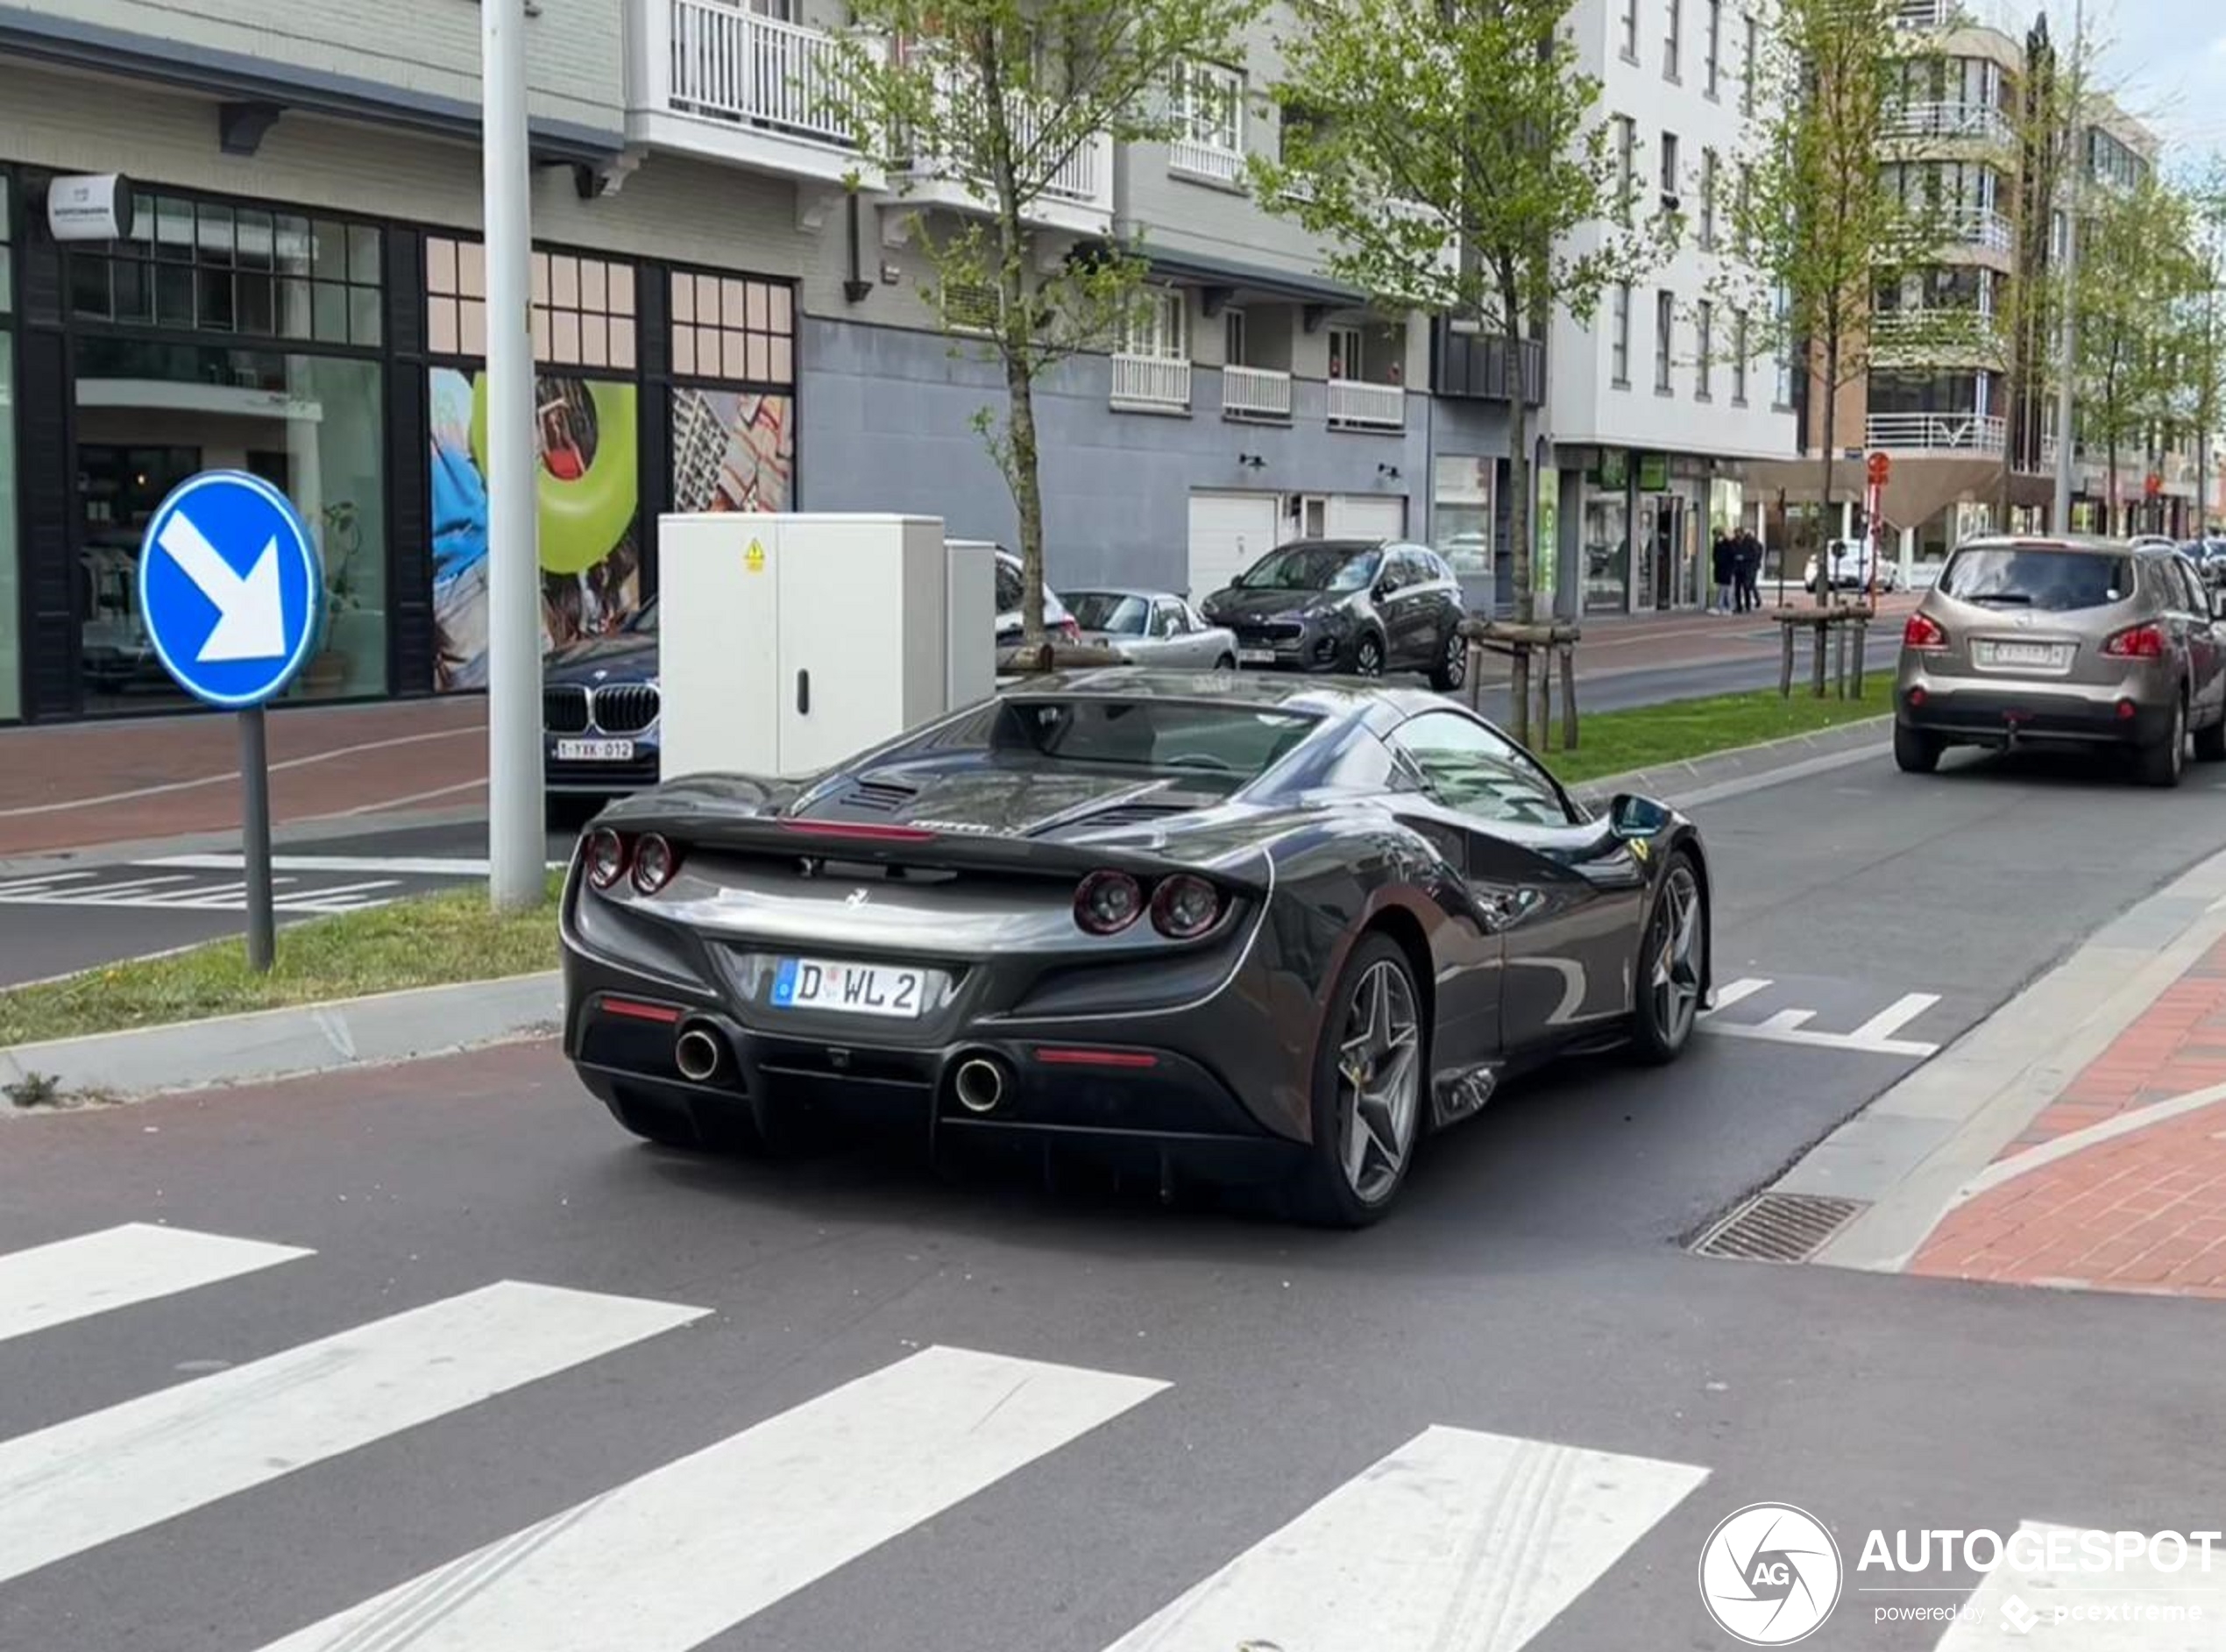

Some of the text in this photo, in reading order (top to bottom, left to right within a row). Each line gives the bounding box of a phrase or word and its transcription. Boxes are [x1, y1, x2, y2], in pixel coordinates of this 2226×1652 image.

[798, 965, 822, 1000] D
[844, 968, 885, 1004] WL
[893, 974, 916, 1009] 2
